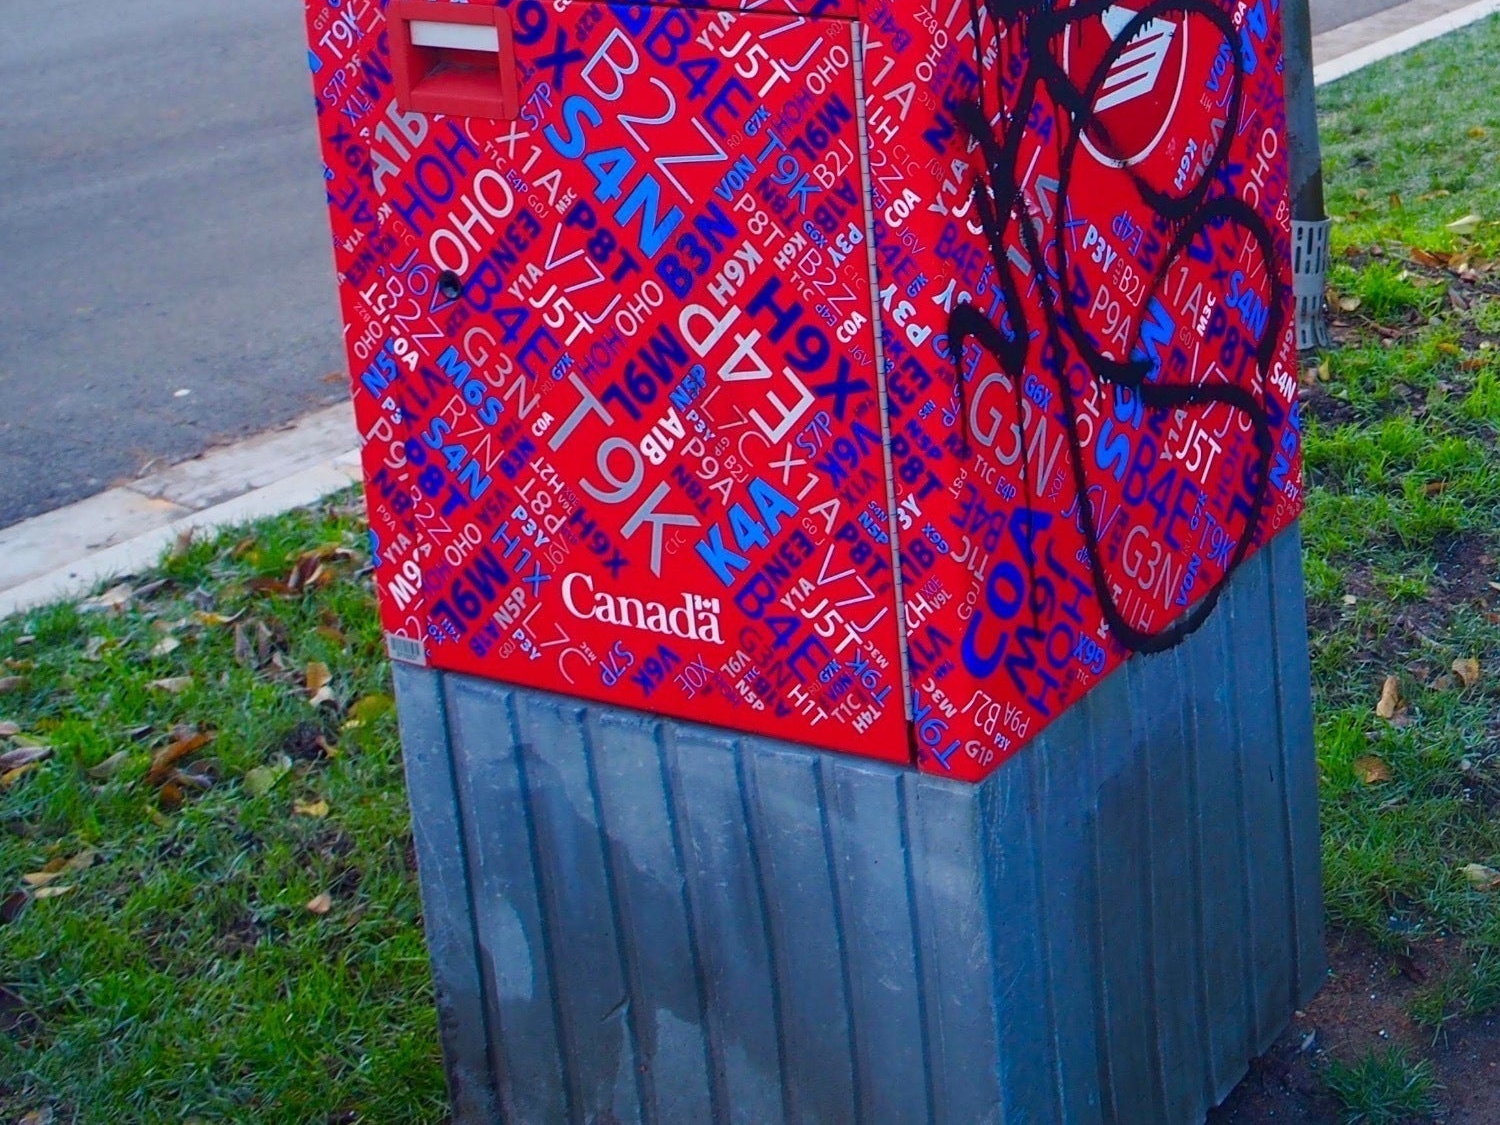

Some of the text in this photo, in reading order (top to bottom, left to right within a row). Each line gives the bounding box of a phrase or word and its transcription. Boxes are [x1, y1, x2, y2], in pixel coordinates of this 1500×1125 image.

[867, 0, 912, 53] B4E
[643, 7, 754, 138] B4E
[719, 30, 792, 98] J5T
[581, 27, 728, 205] B2Z
[789, 92, 851, 162] M9L
[495, 120, 563, 207] X1A
[543, 94, 685, 259] S4N
[756, 128, 823, 215] T9K
[812, 138, 855, 190] B2J
[927, 158, 969, 216] Y1A
[490, 208, 542, 273] E3N
[564, 200, 641, 283] P8T
[733, 193, 785, 247] P8T
[814, 177, 859, 234] A1B
[545, 222, 622, 324] V7J
[655, 201, 739, 300] B3N
[706, 239, 764, 307] K6H
[797, 247, 858, 316] B2Z
[1082, 224, 1118, 273] P3Y
[386, 276, 444, 356] B2Z
[461, 259, 561, 380] B4E
[528, 284, 594, 347] J5T
[880, 284, 931, 347] P3Y
[1088, 284, 1131, 355] P9A
[1224, 270, 1270, 341] S4N
[463, 327, 540, 420] G3N
[601, 324, 690, 421] M9L
[678, 303, 815, 444] E4P
[746, 277, 872, 421] H9X
[1206, 303, 1256, 385] P8T
[436, 345, 504, 426] M6S
[668, 364, 707, 412] N5P
[421, 417, 492, 501] S4N
[440, 394, 505, 472] R7N
[640, 407, 686, 466] A1B
[700, 385, 770, 467] L7C
[815, 420, 882, 489] V6K
[1175, 420, 1222, 484] J5T
[548, 372, 702, 578] T9K
[680, 436, 734, 506] P9A
[768, 442, 841, 534] X1A
[890, 434, 943, 500] P8T
[1122, 435, 1200, 551] B4E
[411, 484, 453, 546] B2Z
[515, 478, 566, 535] P8T
[570, 507, 629, 577] H9X
[695, 477, 799, 587] K4A
[1199, 511, 1236, 572] T9K
[491, 521, 552, 598] H1X
[763, 528, 816, 586] E3N
[835, 521, 890, 579] P8T
[950, 535, 990, 582] T1C
[1122, 525, 1183, 610] G3N
[430, 545, 510, 638] M9L
[561, 572, 725, 645] Canada
[817, 543, 888, 632] V7J
[522, 602, 591, 685] L7C
[733, 572, 832, 683] B4E
[800, 598, 864, 654] J5T
[845, 648, 892, 708] T9K
[961, 689, 1002, 735] B2J
[914, 689, 961, 770] T9K
